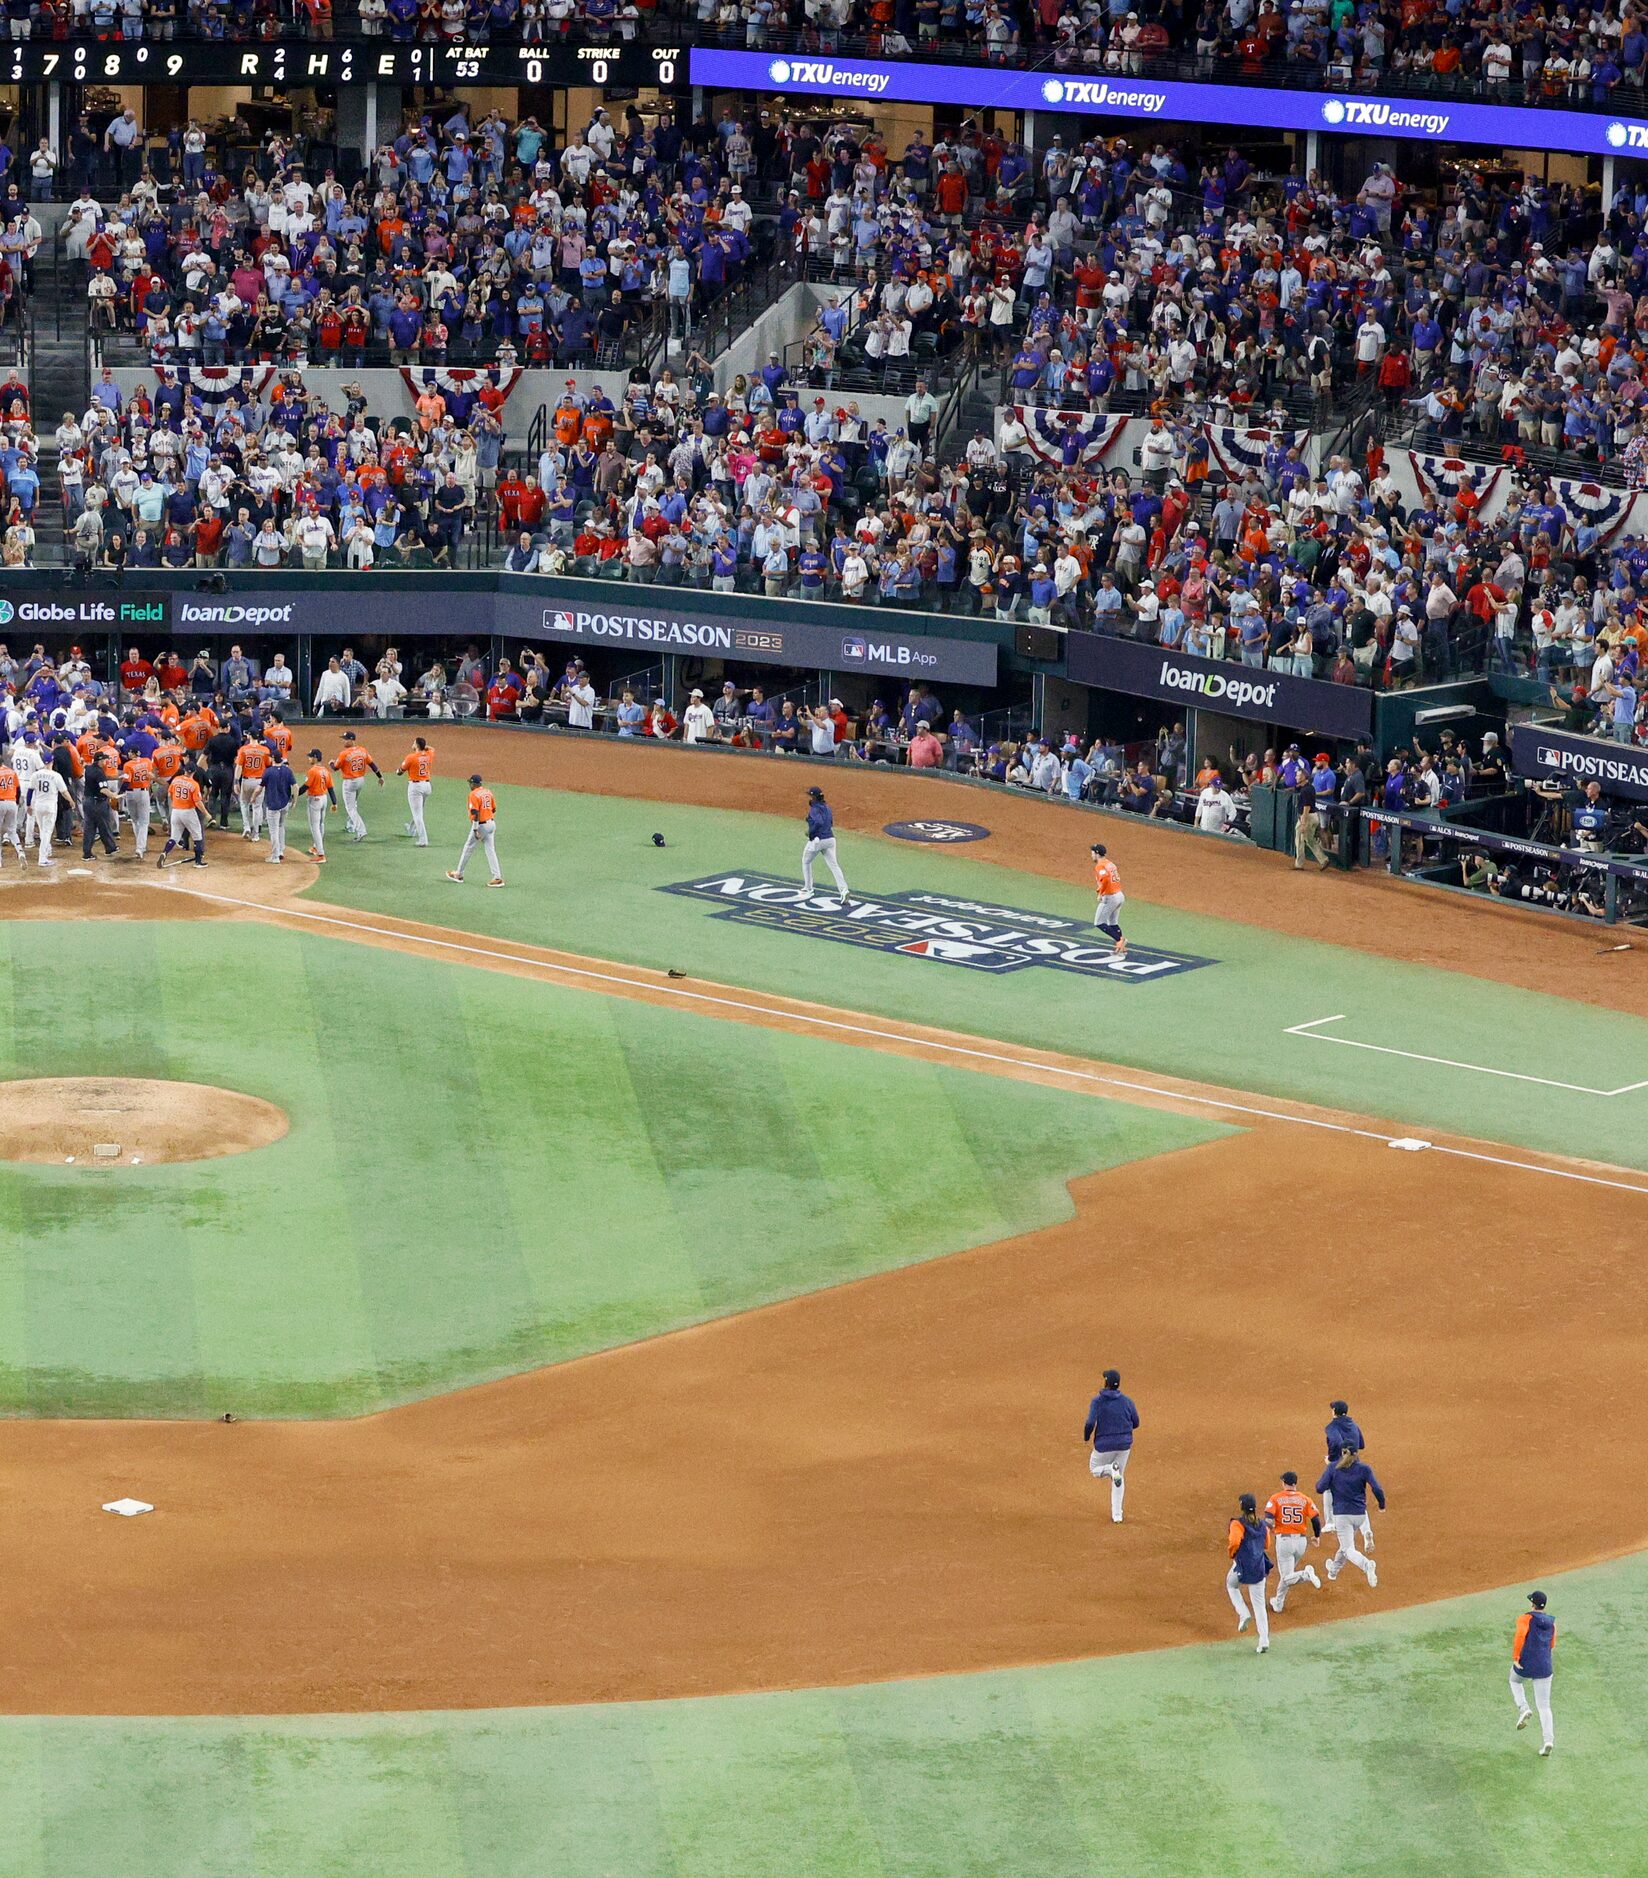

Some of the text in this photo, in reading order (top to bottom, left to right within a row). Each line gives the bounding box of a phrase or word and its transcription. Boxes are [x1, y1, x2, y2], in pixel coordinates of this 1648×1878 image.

[14, 48, 21, 61] 1
[75, 48, 85, 61] 0
[137, 48, 148, 61] 0
[274, 49, 285, 62] 2
[342, 49, 352, 62] 6
[411, 49, 421, 62] 0
[446, 48, 489, 58] AT BAT
[519, 48, 549, 58] BALL
[578, 48, 620, 58] STRIKE
[652, 49, 679, 59] OUT
[44, 55, 59, 74] 7
[105, 55, 120, 75] 8
[167, 55, 182, 75] 9
[241, 54, 258, 74] R
[308, 55, 328, 74] H
[379, 55, 394, 74] E
[456, 62, 479, 76] 53
[12, 66, 22, 79] 3
[75, 66, 85, 79] 0
[274, 67, 284, 80] 4
[342, 67, 352, 80] 6
[413, 68, 420, 81] 1
[527, 61, 541, 82] 0
[593, 61, 607, 82] 0
[660, 62, 674, 83] 0
[1269, 452, 1279, 464] T
[504, 490, 520, 498] TEXA
[18, 603, 162, 621] Globe Life Field
[182, 604, 292, 625] loanDepot
[576, 612, 782, 650] POSTSEASON 2023
[868, 644, 936, 666] MLB App
[1160, 662, 1274, 708] loanDepot
[16, 758, 28, 770] 83
[166, 756, 173, 768] 2
[246, 757, 261, 768] 30
[0, 776, 14, 789] 44
[38, 780, 50, 792] 18
[176, 786, 188, 799] 99
[695, 877, 1180, 975] POSTSEASON
[743, 908, 911, 945] 2023
[1282, 1506, 1302, 1524] 55
